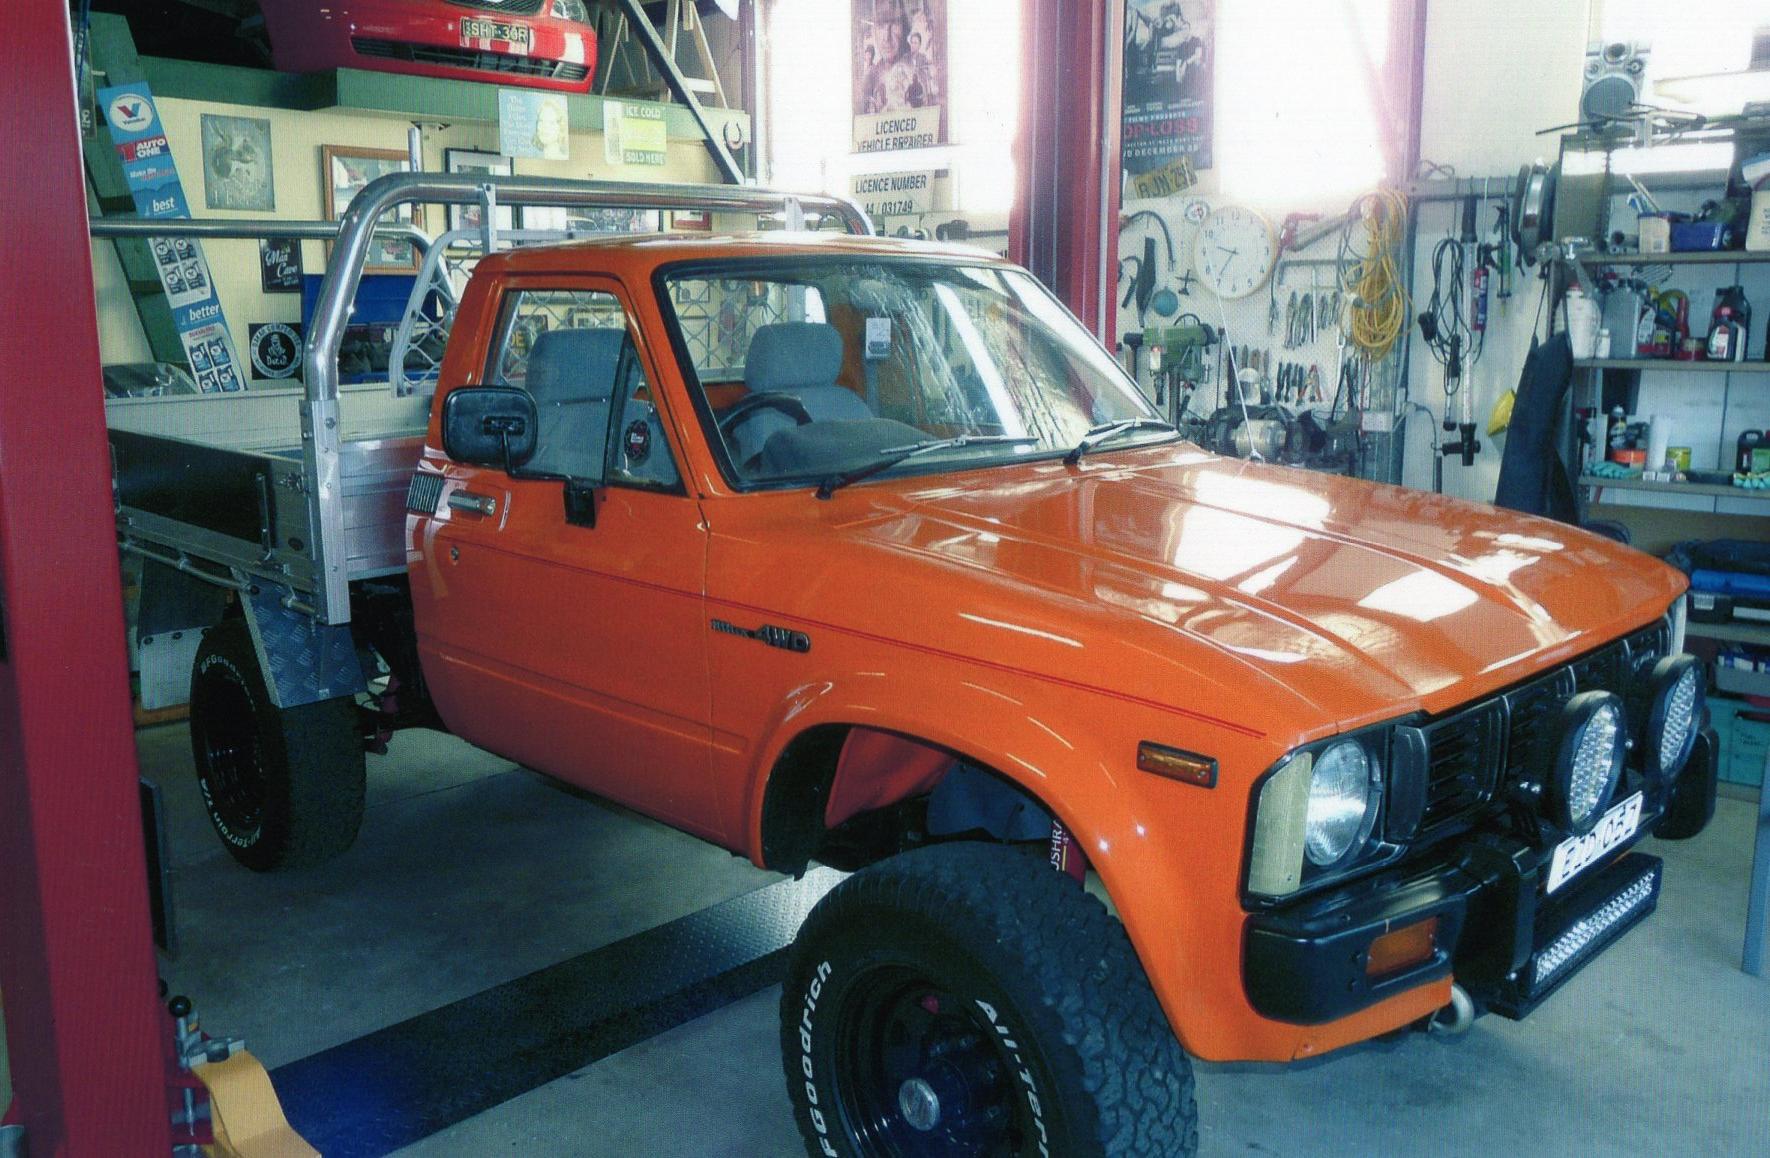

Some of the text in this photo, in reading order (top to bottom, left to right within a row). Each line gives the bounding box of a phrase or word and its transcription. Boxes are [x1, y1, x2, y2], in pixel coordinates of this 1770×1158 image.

[626, 105, 660, 118] ICE COLD
[876, 118, 917, 135] LICENCED
[136, 138, 166, 149] AUTO
[857, 133, 933, 153] VEHICLE REPAIRER
[136, 147, 160, 158] ONE
[626, 152, 664, 165] SOLD HERE
[856, 174, 927, 194] LICENCE NUMBER
[153, 197, 175, 212] best
[265, 249, 288, 266] Man
[189, 303, 220, 321] better
